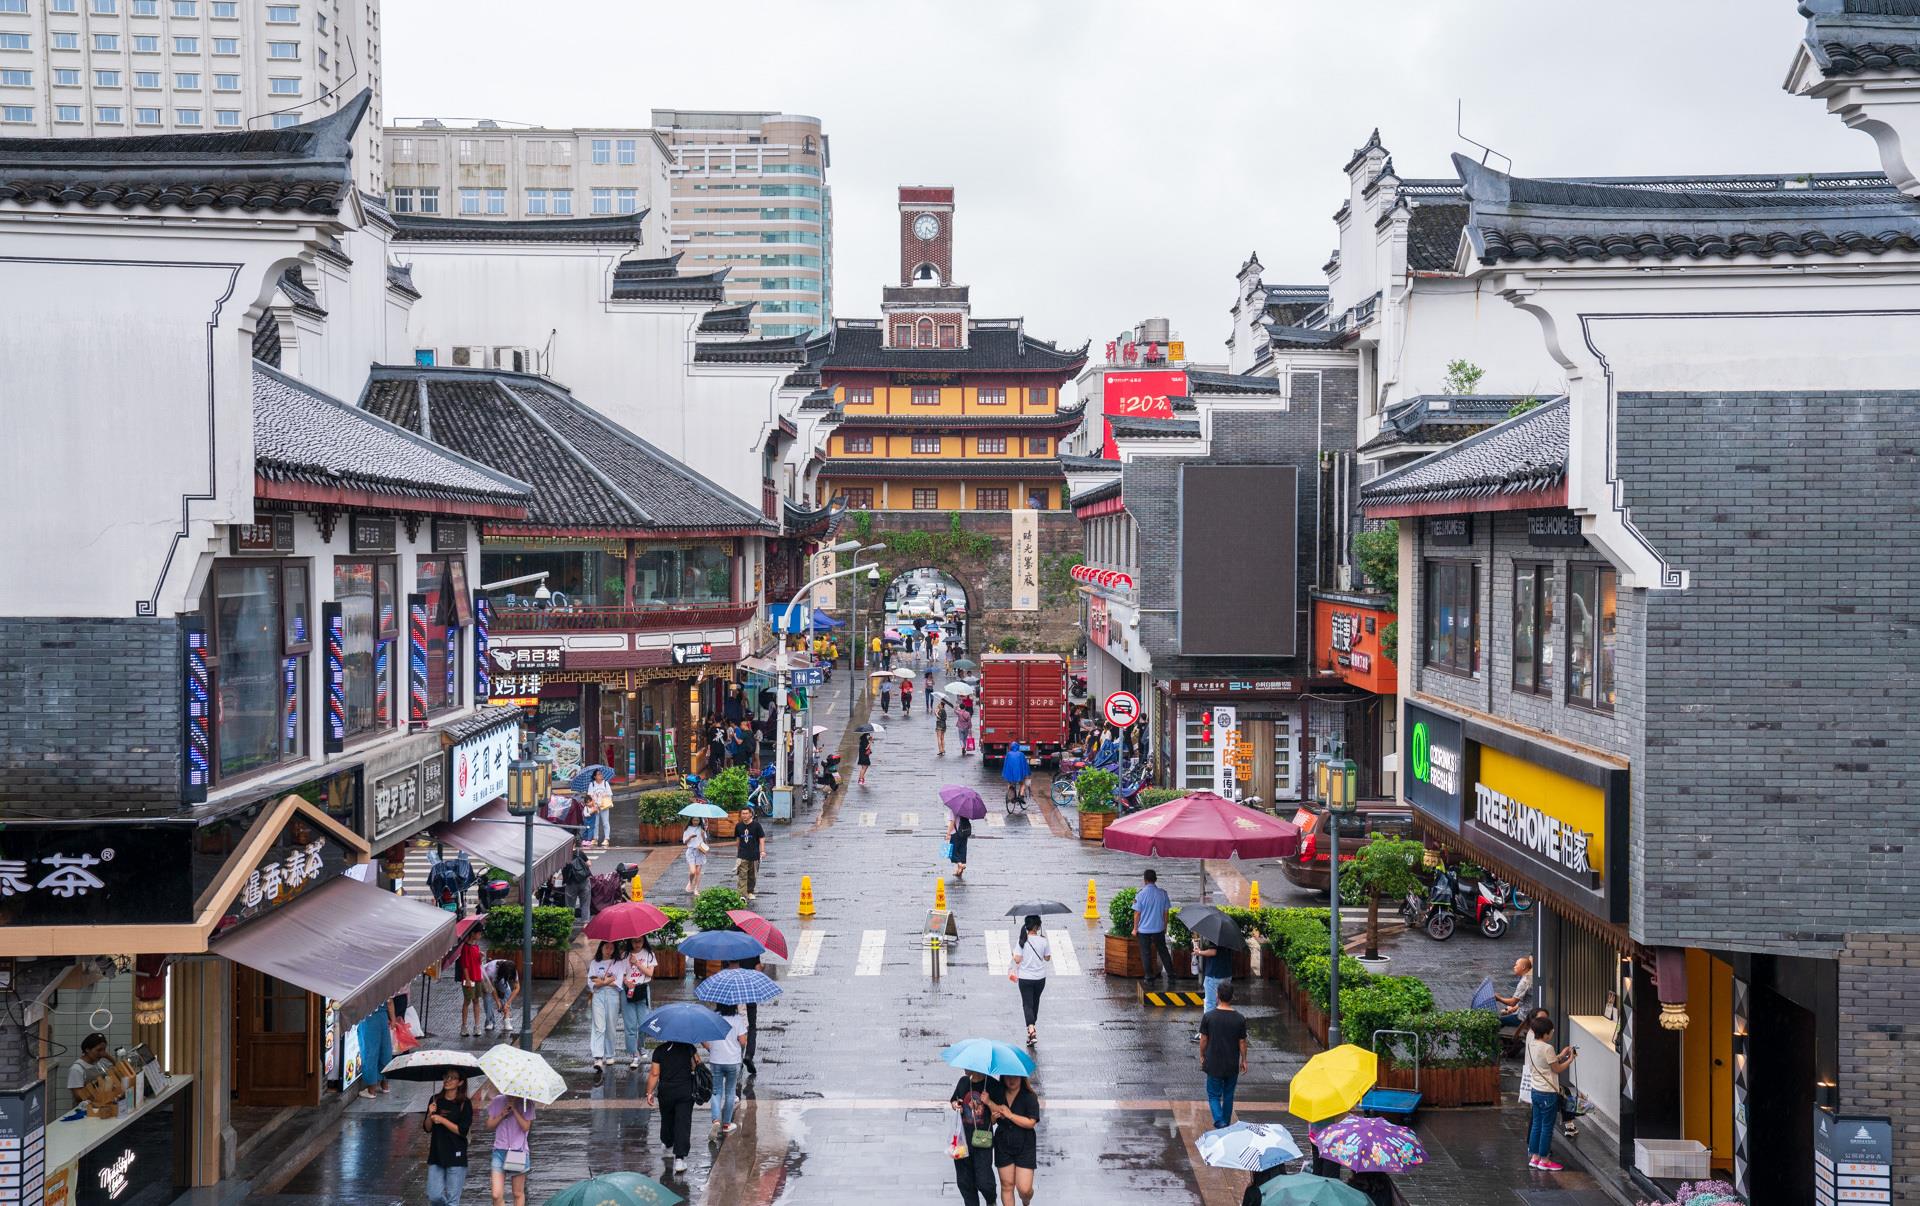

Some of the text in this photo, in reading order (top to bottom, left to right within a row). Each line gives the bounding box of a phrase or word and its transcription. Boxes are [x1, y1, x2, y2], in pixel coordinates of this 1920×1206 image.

[1223, 768, 1233, 798] 宣传街
[1475, 782, 1560, 862] TREE&HOME
